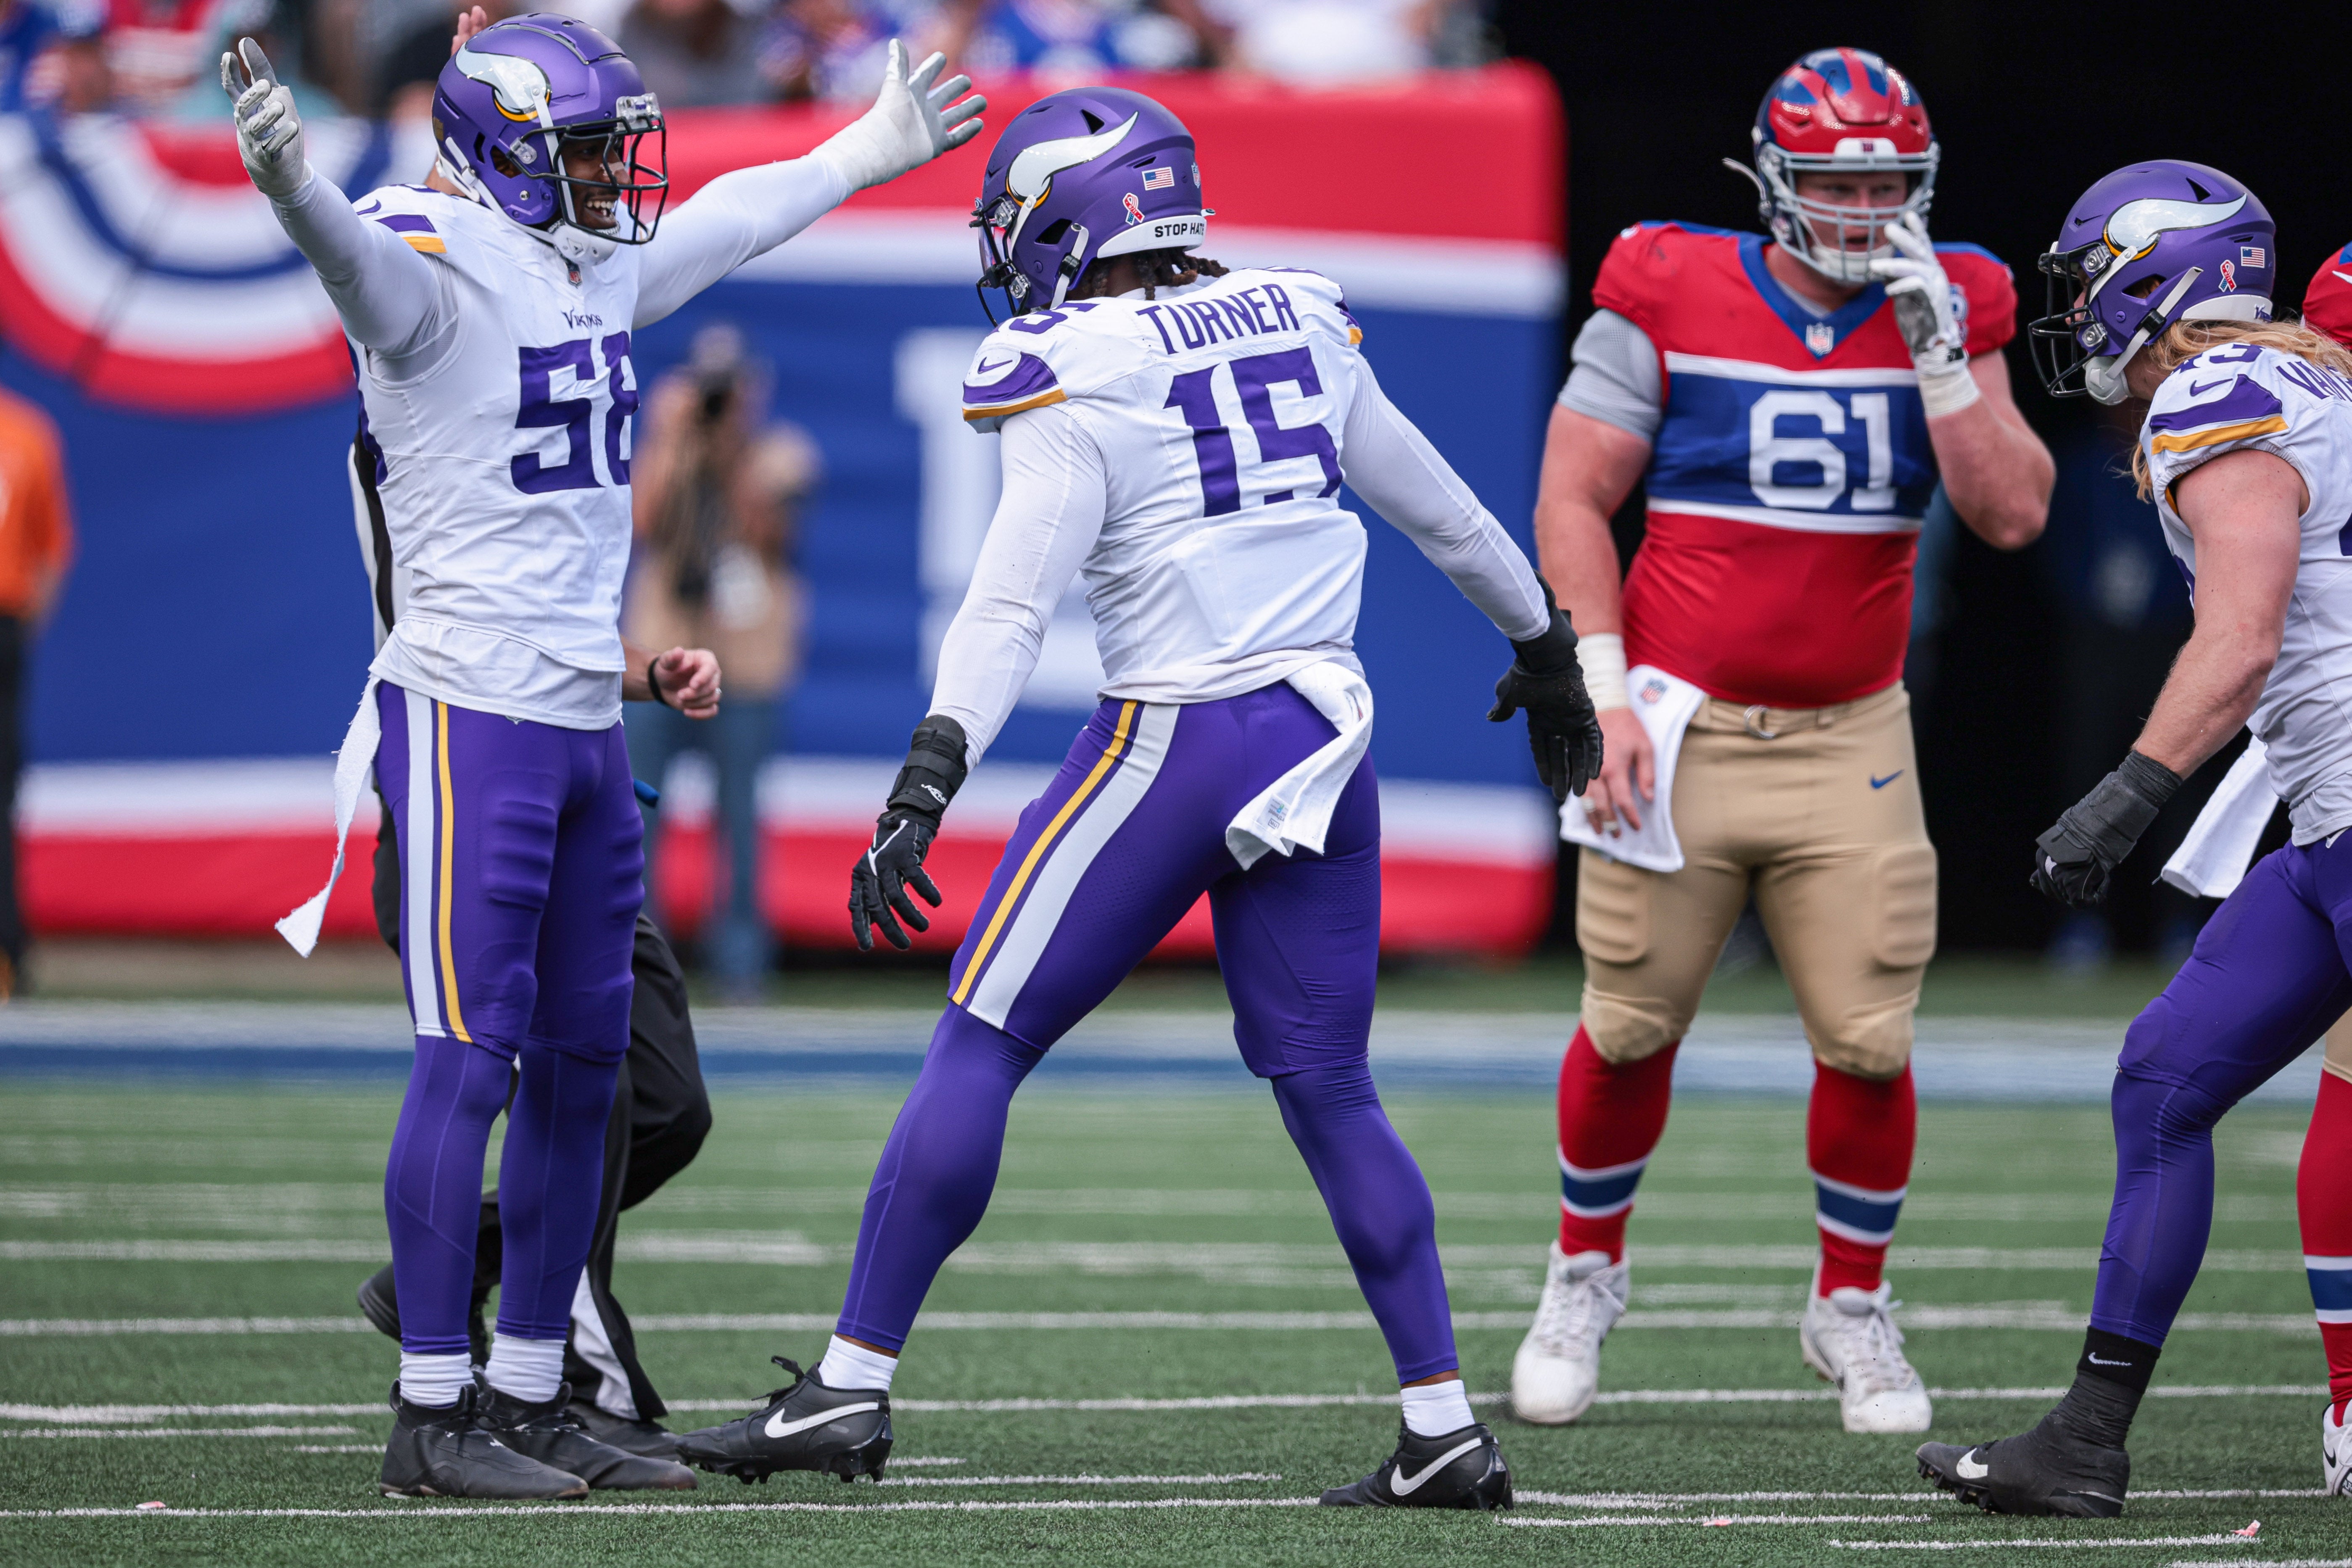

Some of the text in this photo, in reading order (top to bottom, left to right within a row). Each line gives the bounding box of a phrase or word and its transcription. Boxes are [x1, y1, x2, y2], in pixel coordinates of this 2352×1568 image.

[1128, 204, 1137, 214] 9/11
[1155, 223, 1187, 238] STOP
[1135, 283, 1301, 355] TURNER
[511, 331, 639, 494] 58
[1163, 346, 1343, 517] 15
[1749, 390, 1897, 511] 61
